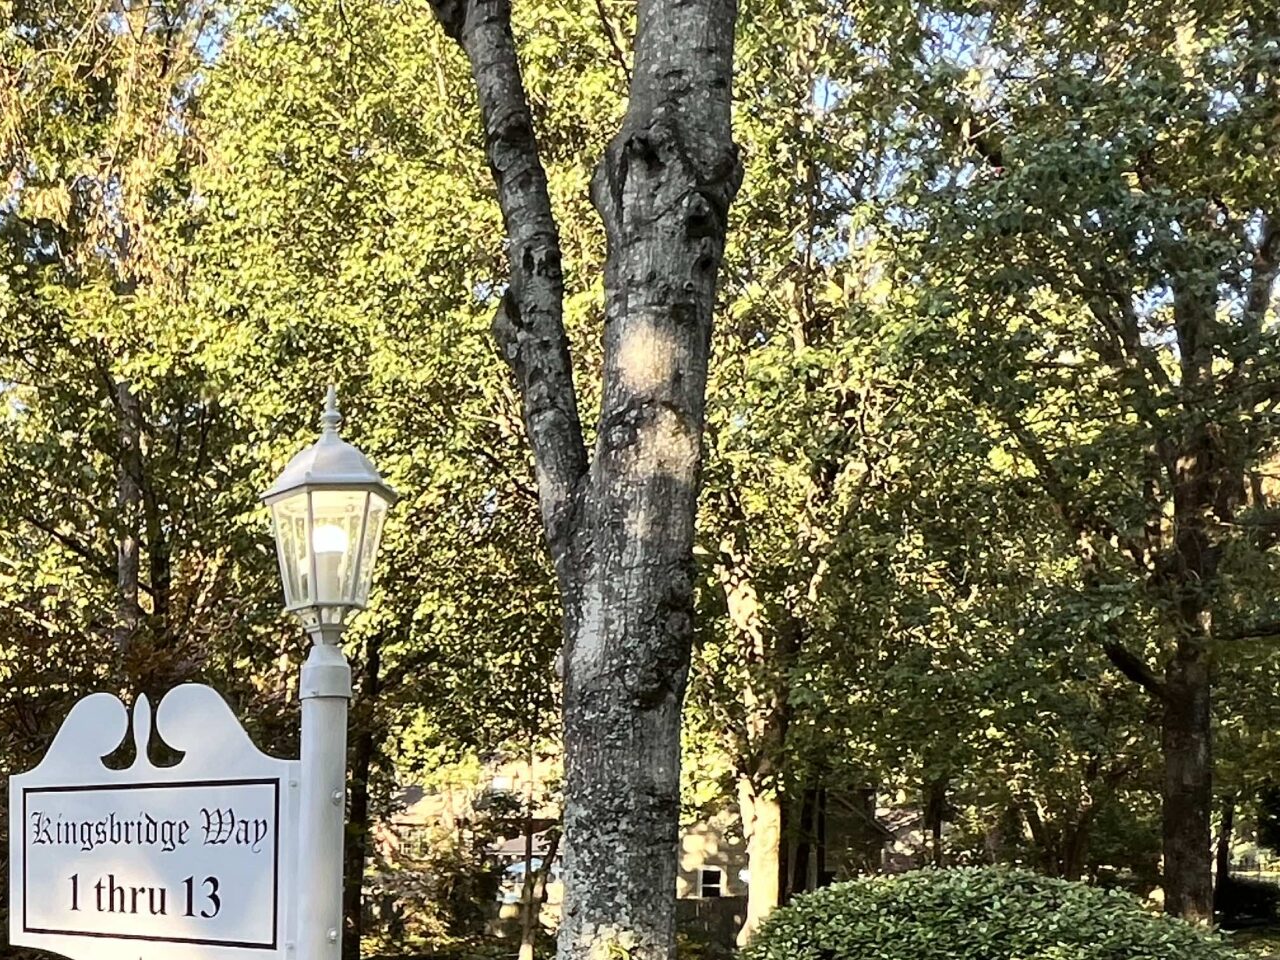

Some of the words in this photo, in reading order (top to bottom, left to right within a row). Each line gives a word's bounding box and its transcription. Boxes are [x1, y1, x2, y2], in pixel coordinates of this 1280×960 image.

[31, 811, 190, 852] Kingsbridge
[200, 808, 268, 853] Way
[69, 873, 81, 911] 1
[95, 874, 167, 915] thru
[182, 876, 221, 918] 13
